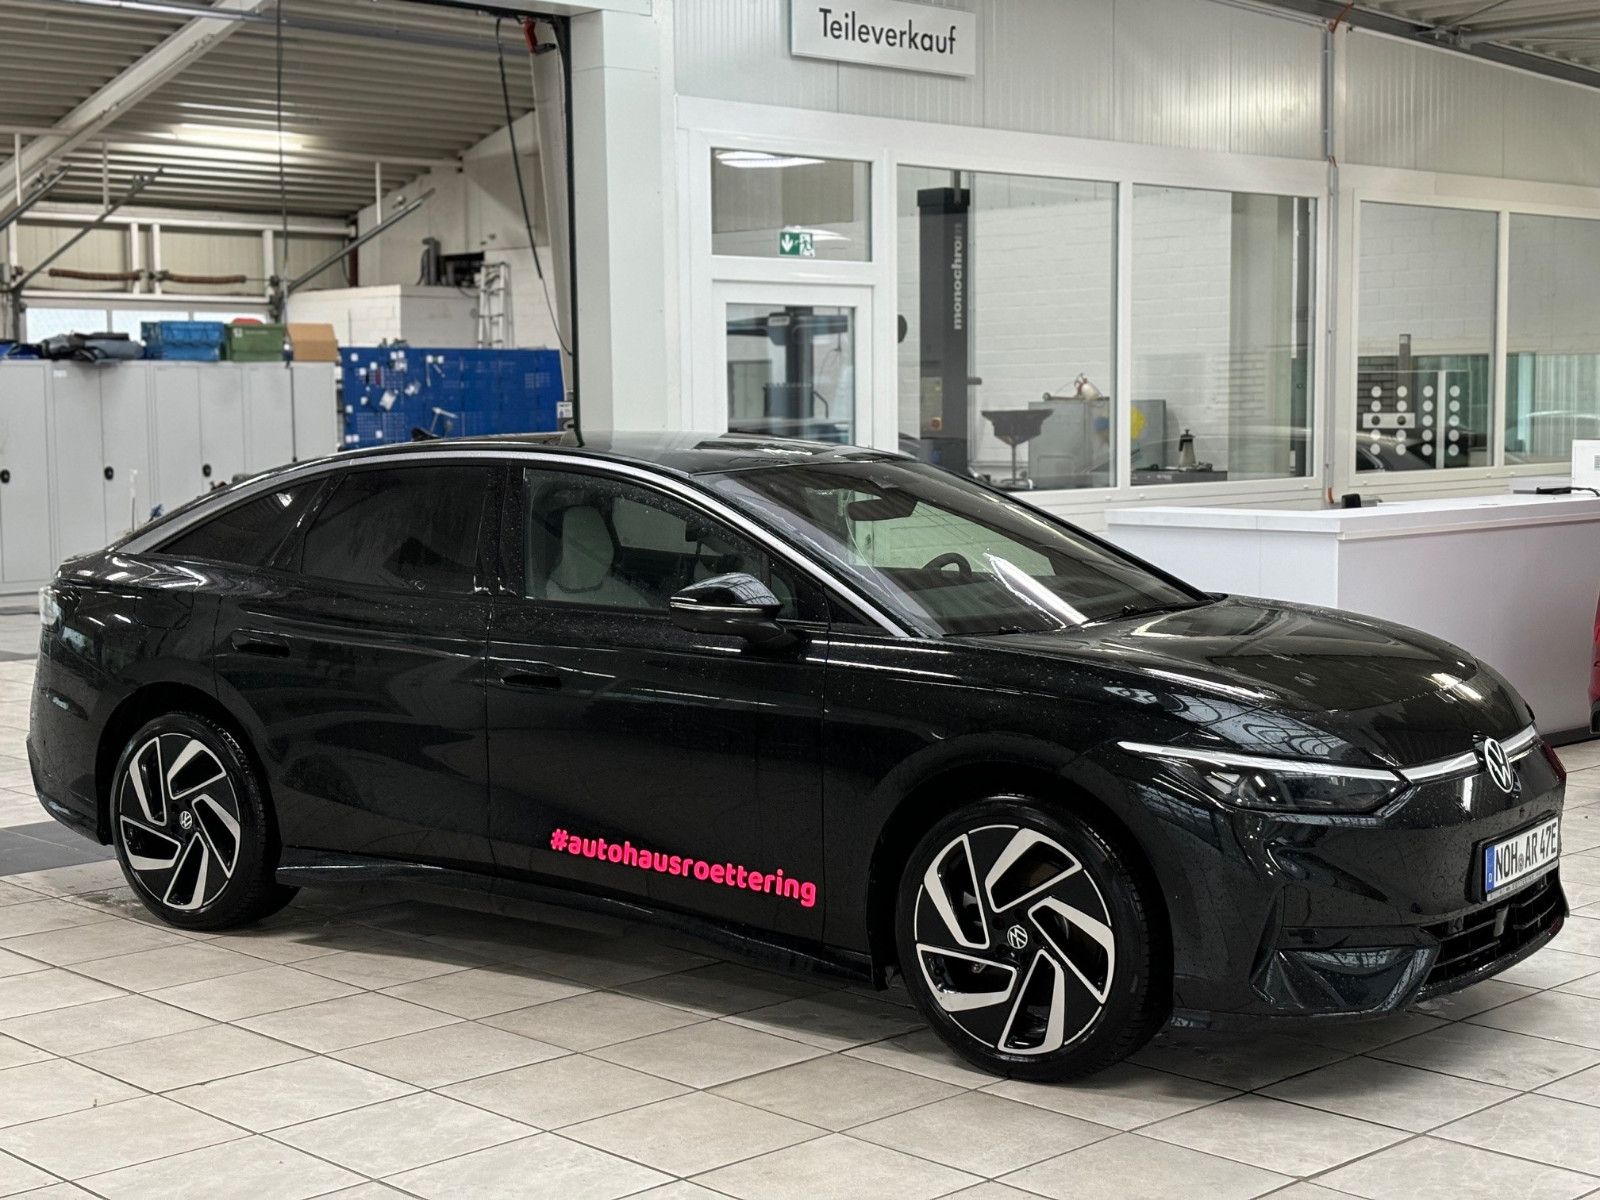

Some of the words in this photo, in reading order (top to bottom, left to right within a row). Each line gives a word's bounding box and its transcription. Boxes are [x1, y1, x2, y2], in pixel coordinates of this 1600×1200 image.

[819, 7, 957, 55] Teileverkauf
[550, 828, 817, 908] #autohausroettering
[1495, 840, 1518, 882] NOH
[1524, 832, 1538, 868] AR
[1539, 822, 1557, 860] 47E
